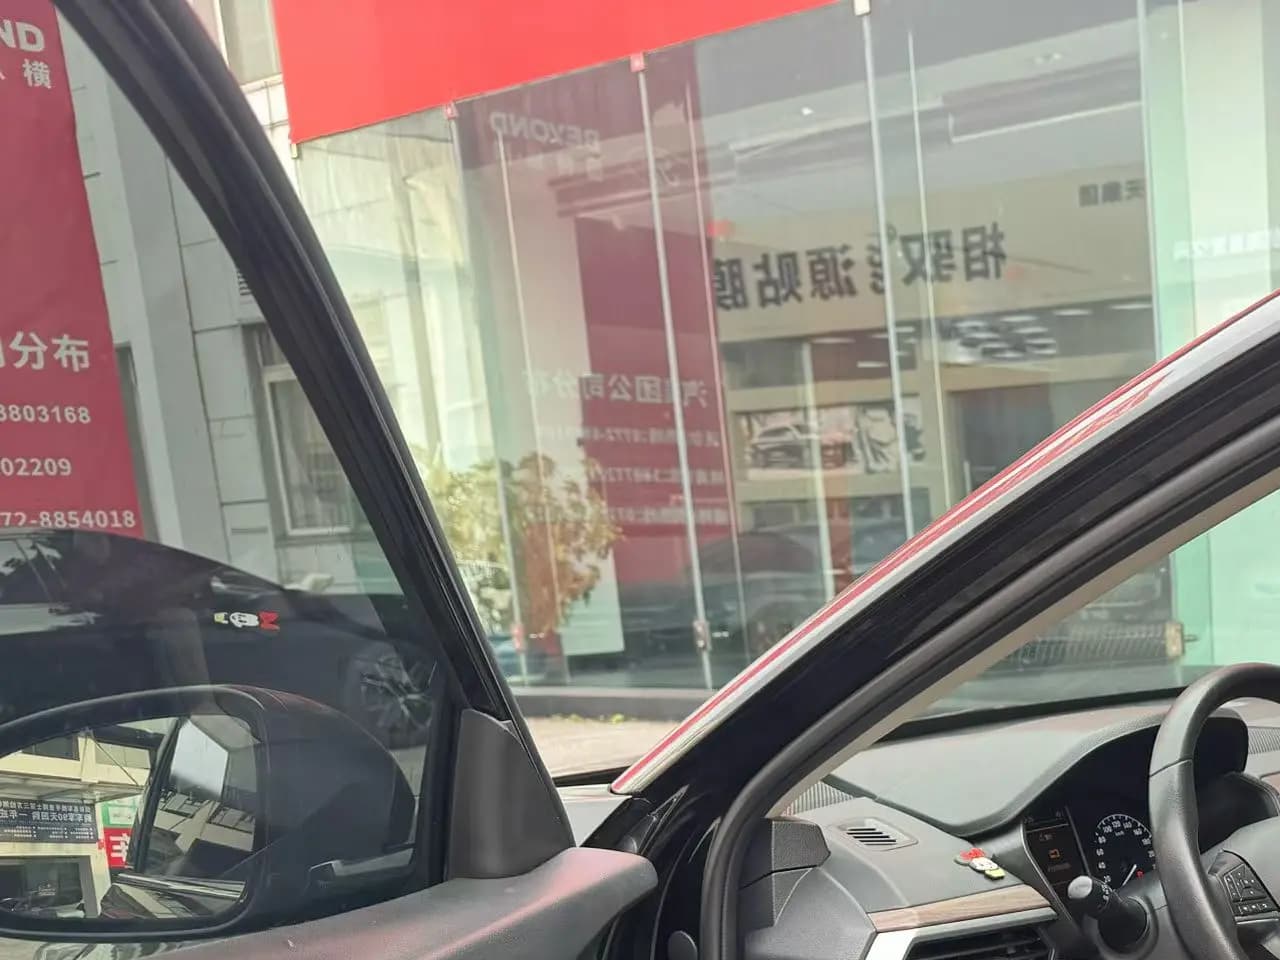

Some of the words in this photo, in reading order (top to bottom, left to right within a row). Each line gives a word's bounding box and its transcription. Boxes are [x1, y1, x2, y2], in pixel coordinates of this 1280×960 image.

[0, 19, 45, 52] ND
[0, 58, 52, 89] 横
[0, 331, 90, 371] 分布
[0, 457, 72, 477] 02209
